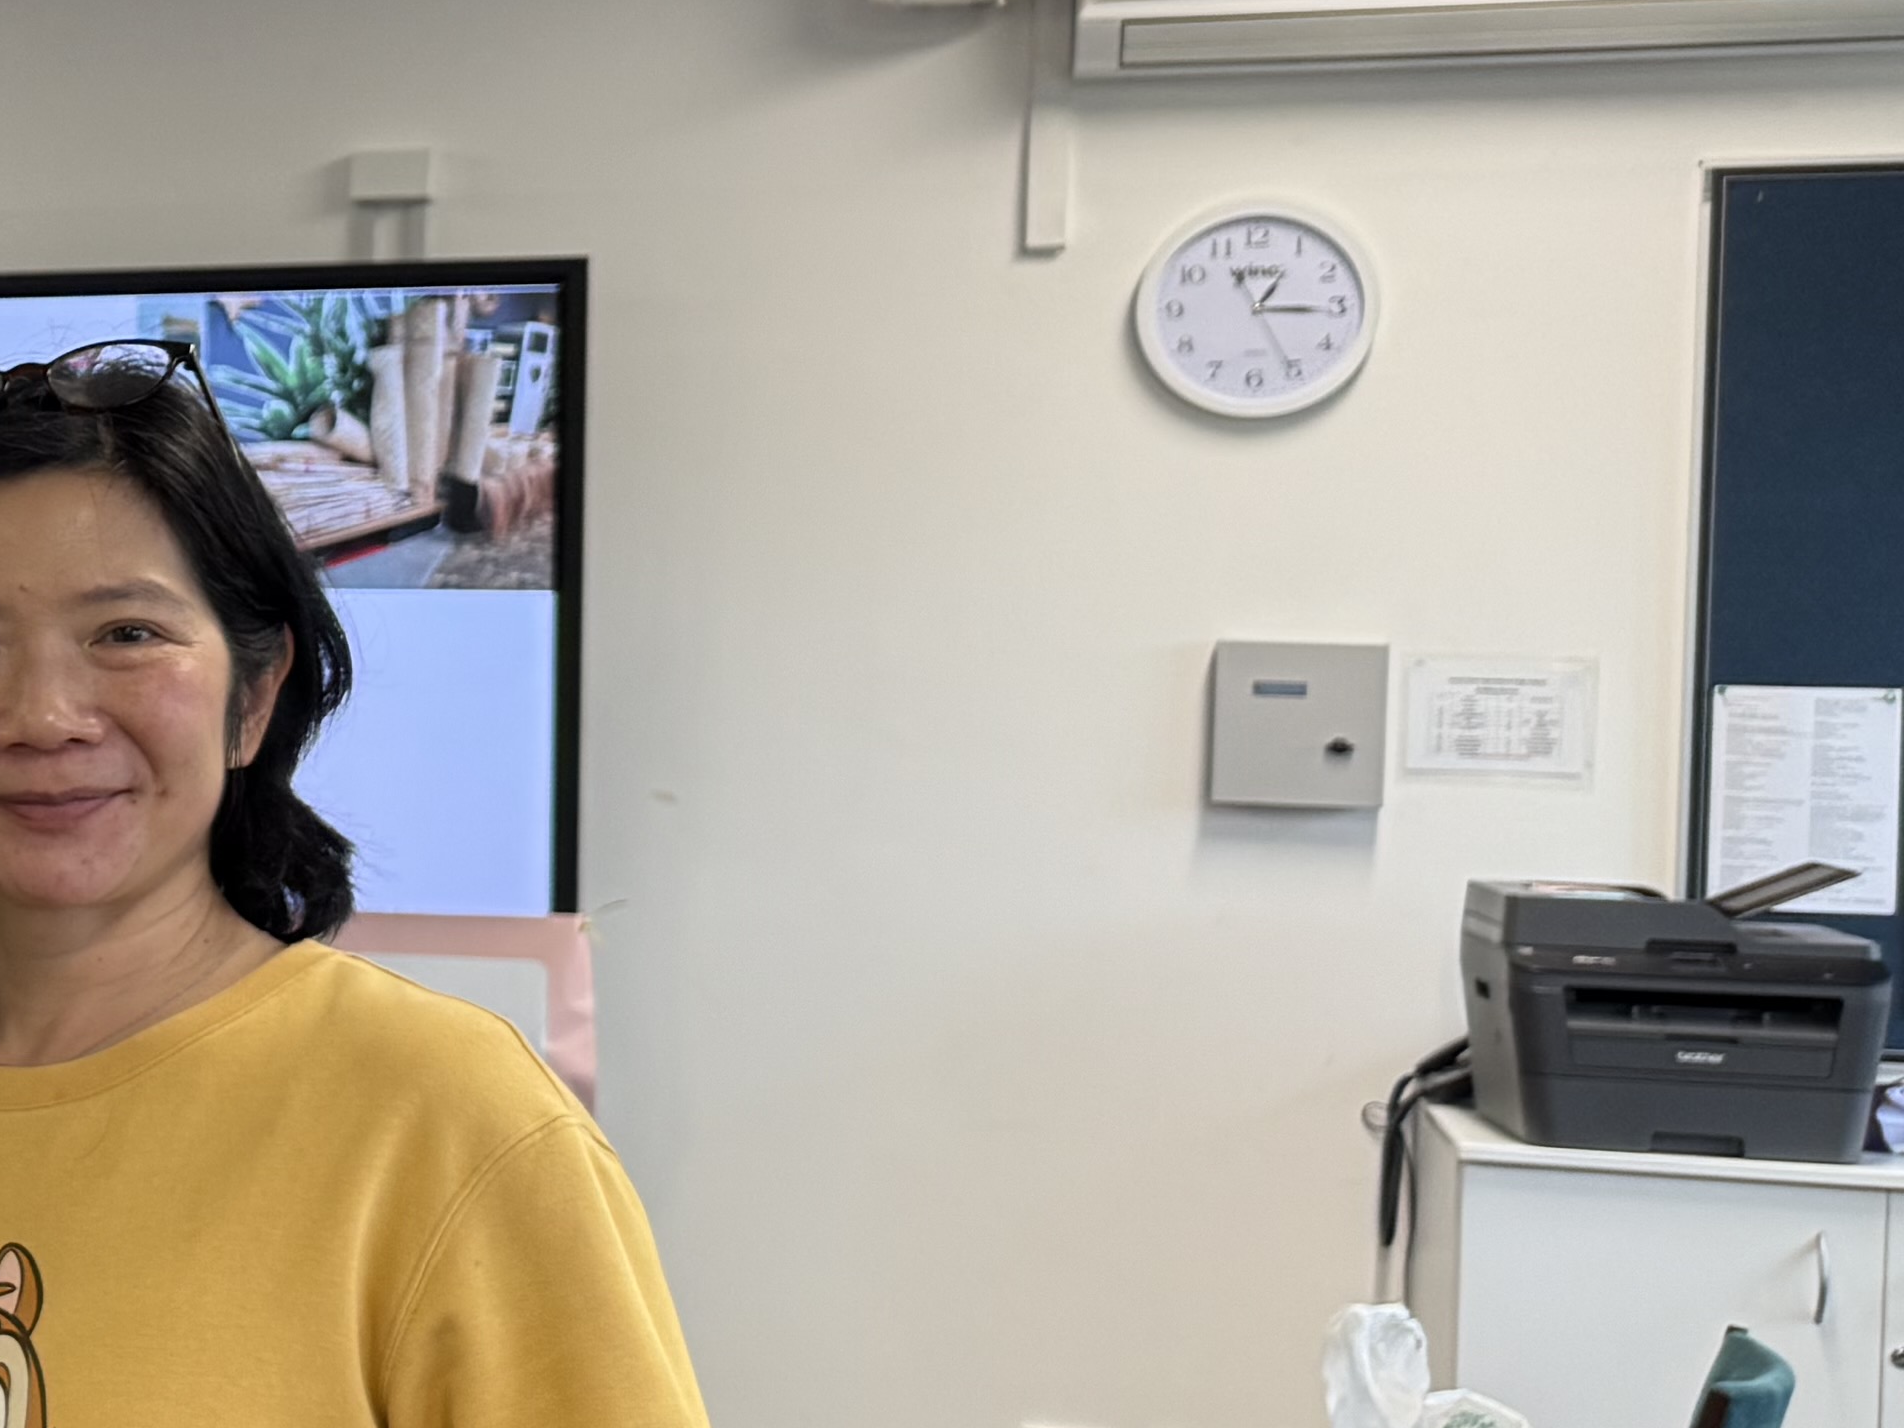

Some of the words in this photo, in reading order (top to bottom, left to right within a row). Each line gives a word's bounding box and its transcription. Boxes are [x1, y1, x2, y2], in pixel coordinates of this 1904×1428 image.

[1245, 225, 1270, 248] 12
[1209, 237, 1233, 259] 11
[1180, 264, 1206, 286] 10
[1319, 261, 1337, 284] 2
[1164, 302, 1185, 320] 9
[1327, 294, 1347, 320] 3
[1176, 334, 1195, 354] 8
[1315, 332, 1333, 352] 4
[1206, 359, 1224, 380] 7
[1244, 367, 1264, 389] 6
[1284, 358, 1303, 380] 5
